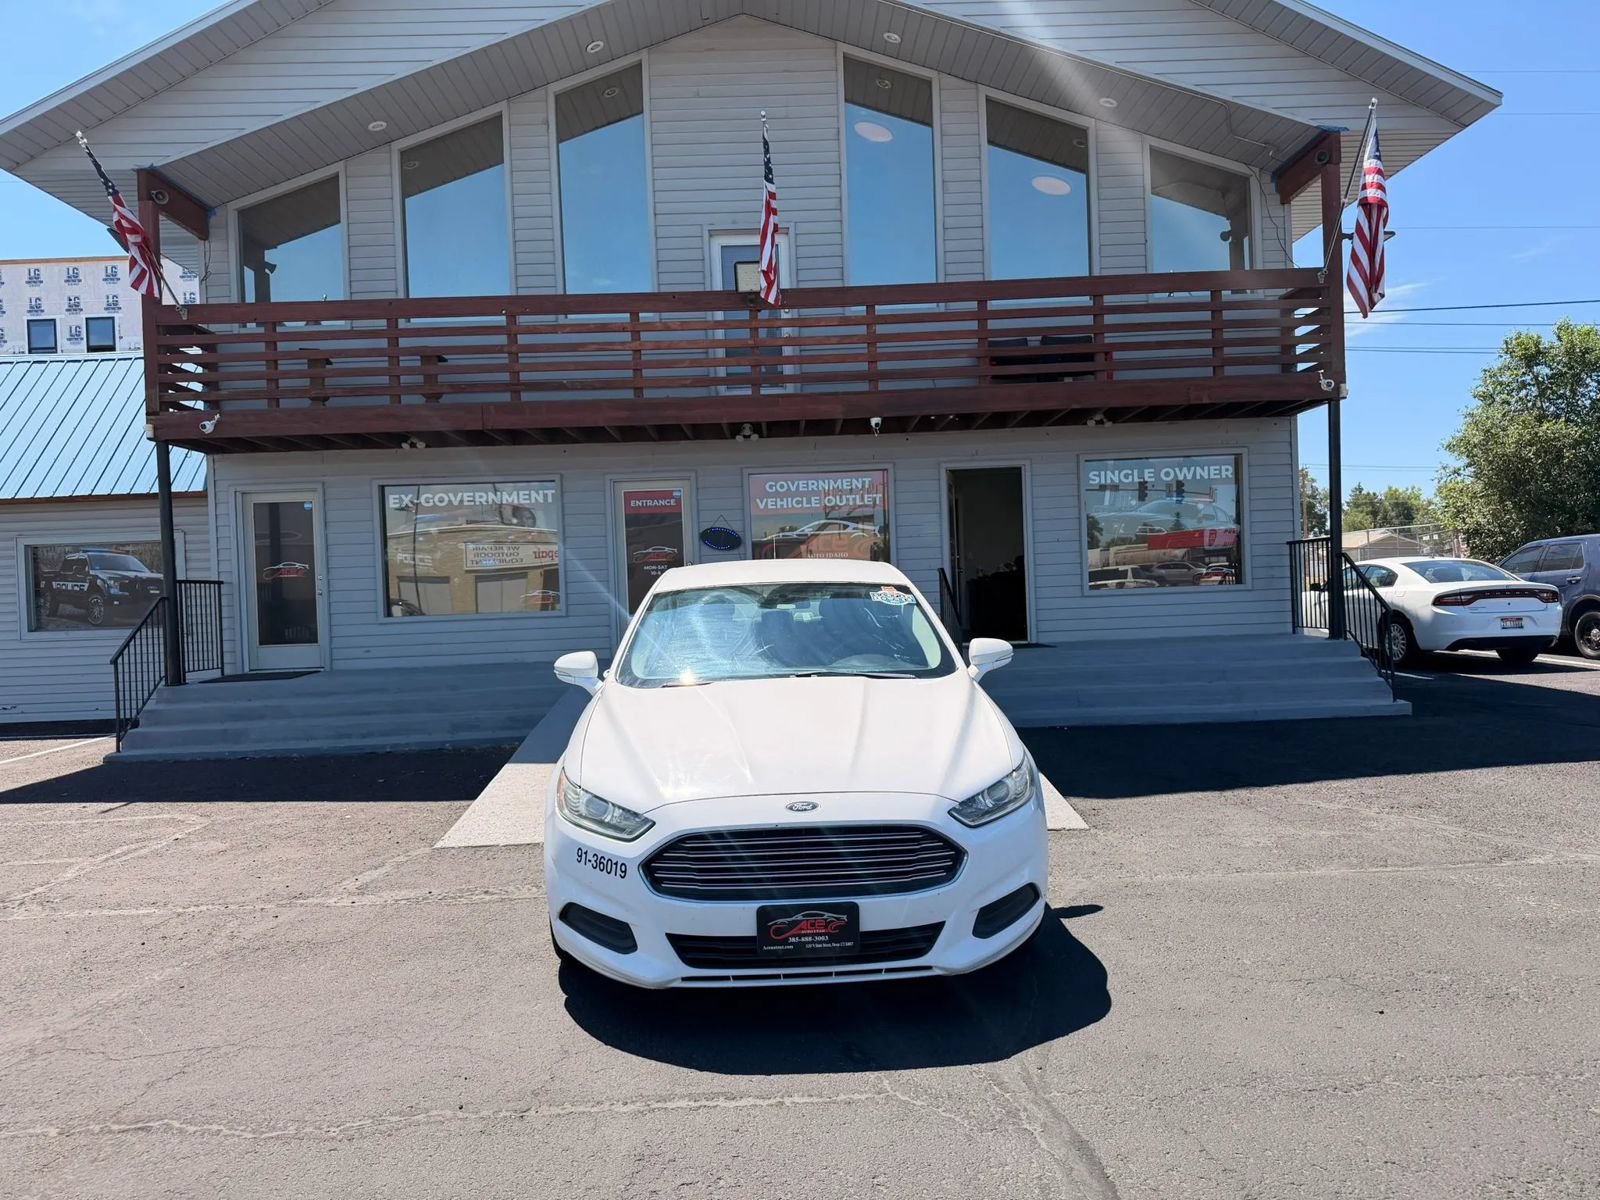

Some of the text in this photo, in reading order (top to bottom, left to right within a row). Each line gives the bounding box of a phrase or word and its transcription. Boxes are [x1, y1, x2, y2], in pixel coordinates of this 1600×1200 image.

[1088, 465, 1233, 485] SINGLE OWNER
[765, 478, 872, 493] GOVERNMENT
[388, 489, 556, 509] EX-GOVERNMENT
[630, 498, 677, 507] ENTRANCE
[756, 494, 882, 510] VEHICLE OUTLET
[792, 802, 813, 811] Ford
[576, 847, 628, 879] 91-36019
